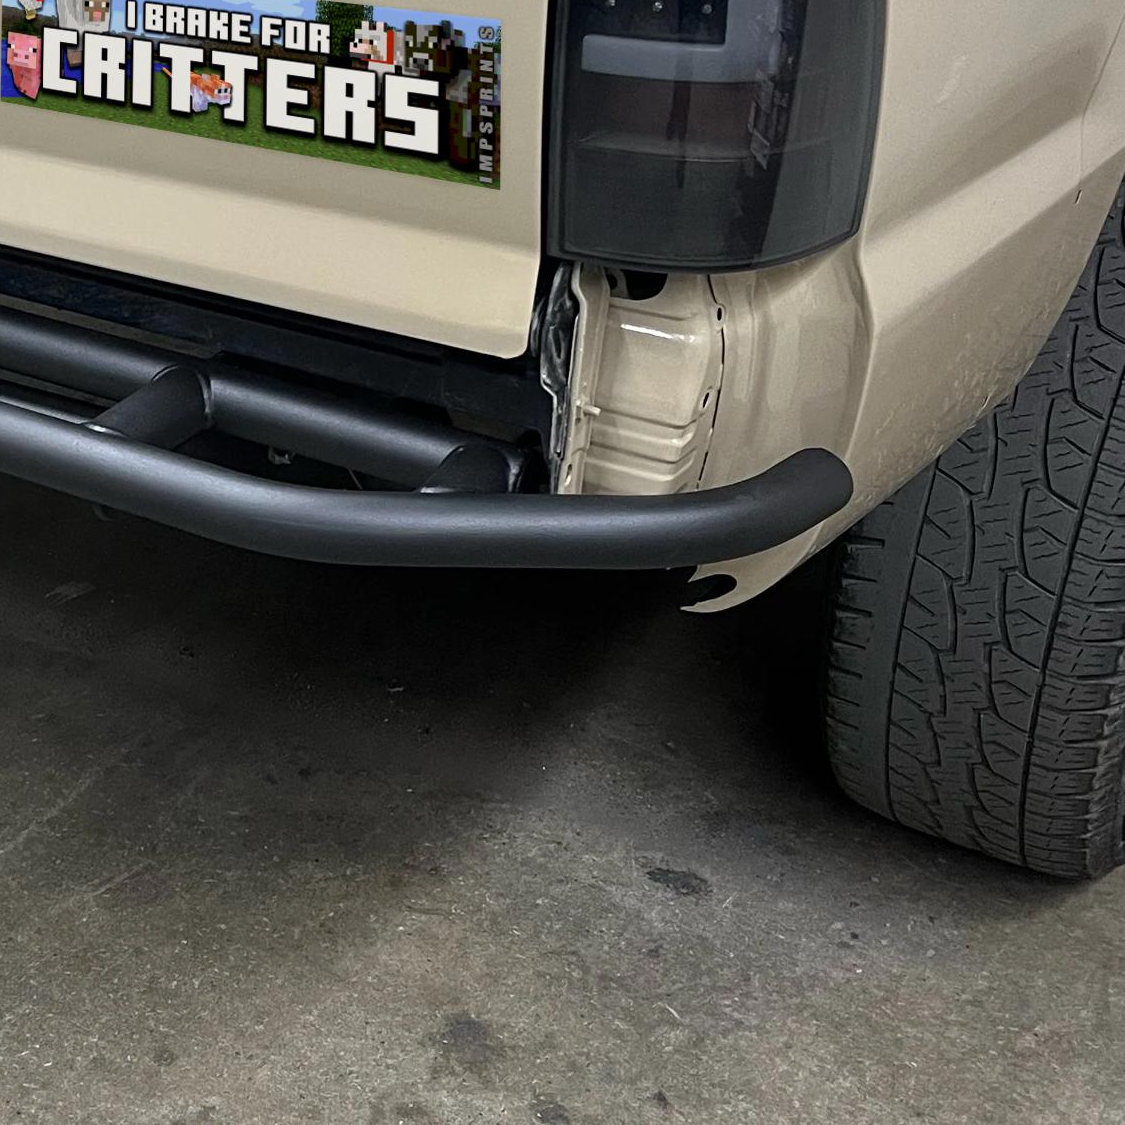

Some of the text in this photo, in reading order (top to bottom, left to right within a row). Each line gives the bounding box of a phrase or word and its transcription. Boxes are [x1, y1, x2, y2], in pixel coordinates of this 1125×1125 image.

[42, 27, 440, 155] CRITTERS
[127, 0, 330, 54] I BRAKE FOR
[478, 25, 496, 185] IMPSPRINTS
